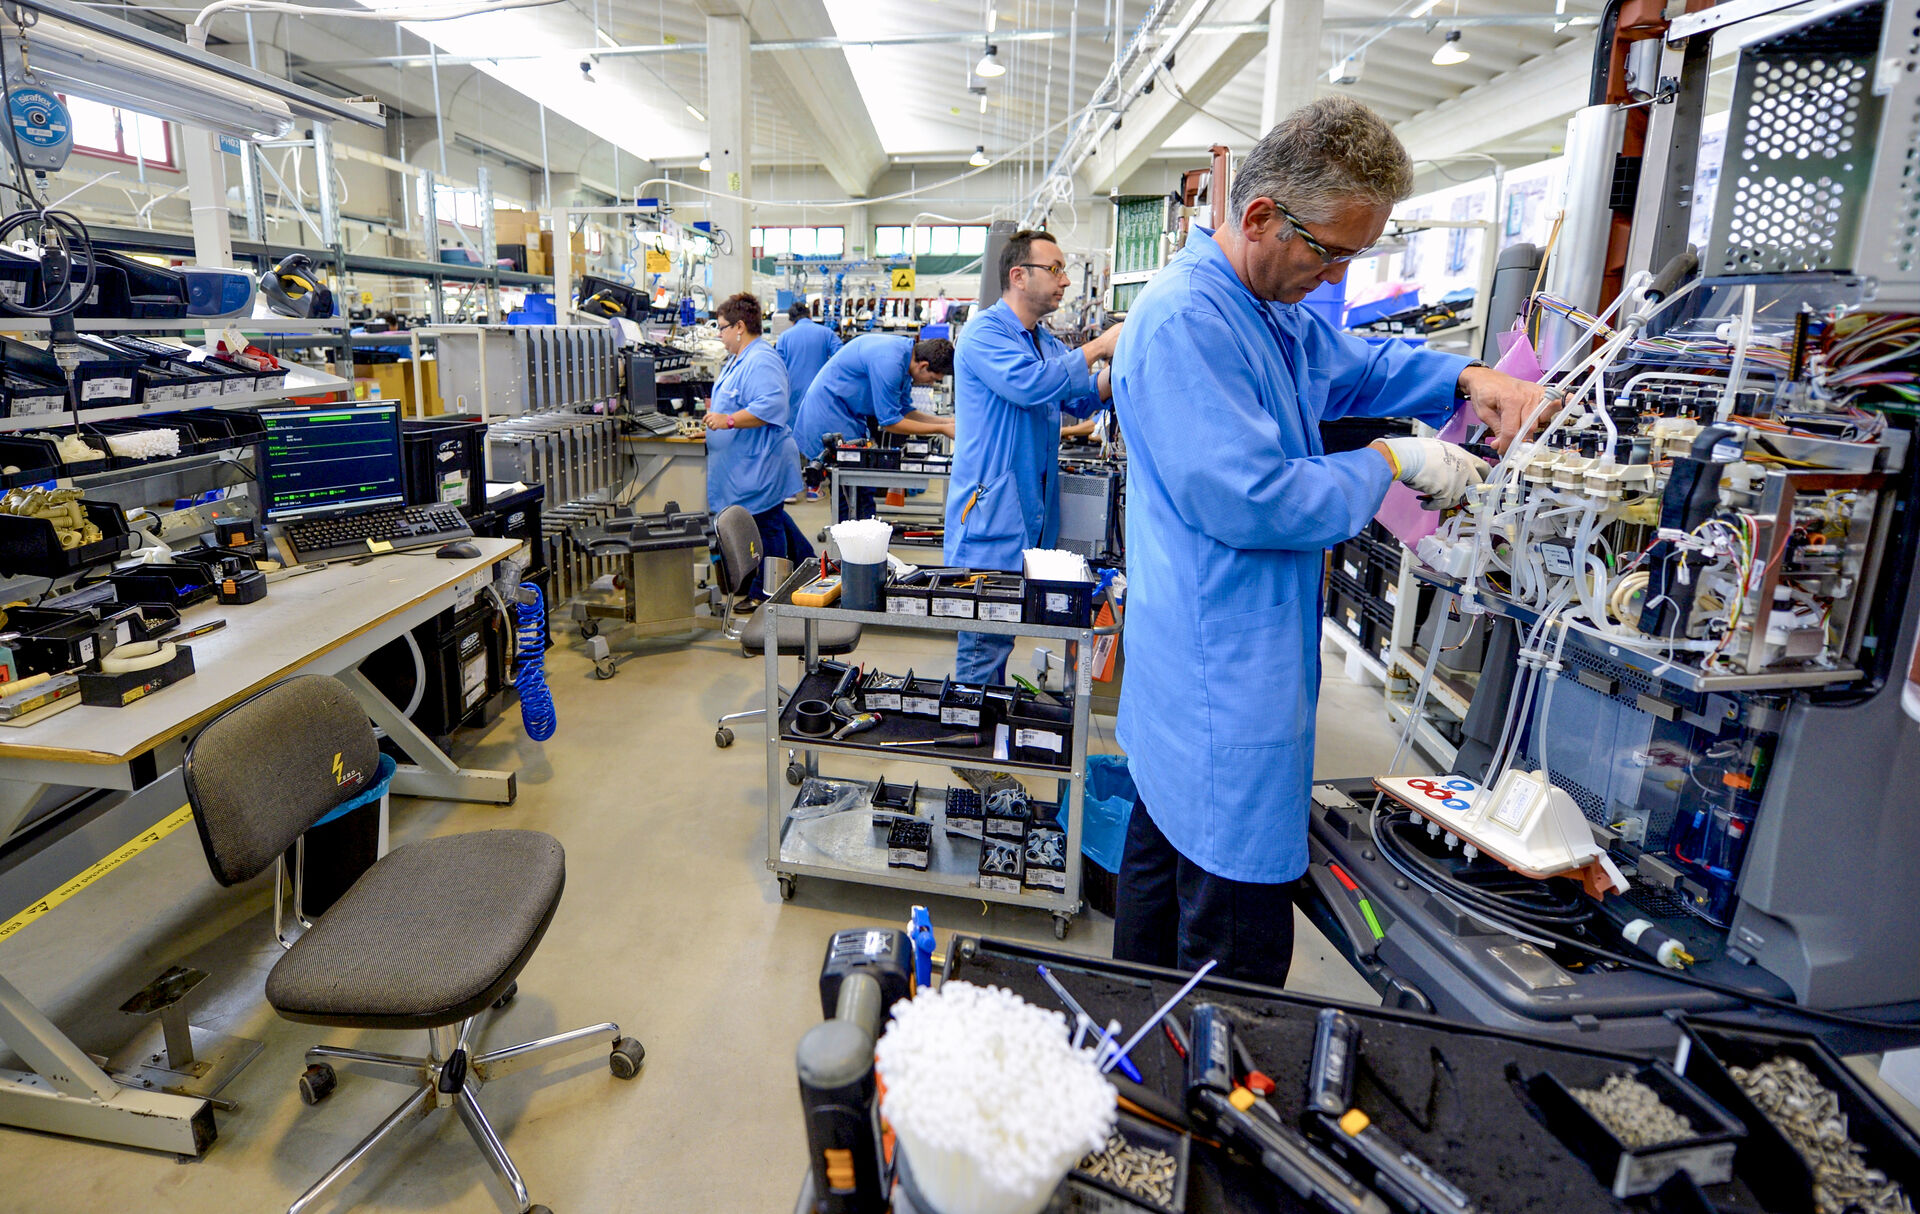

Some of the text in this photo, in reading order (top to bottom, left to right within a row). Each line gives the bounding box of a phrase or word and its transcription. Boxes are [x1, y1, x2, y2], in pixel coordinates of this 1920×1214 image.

[60, 848, 139, 896] ESD Protected Area
[0, 921, 22, 936] ESD
